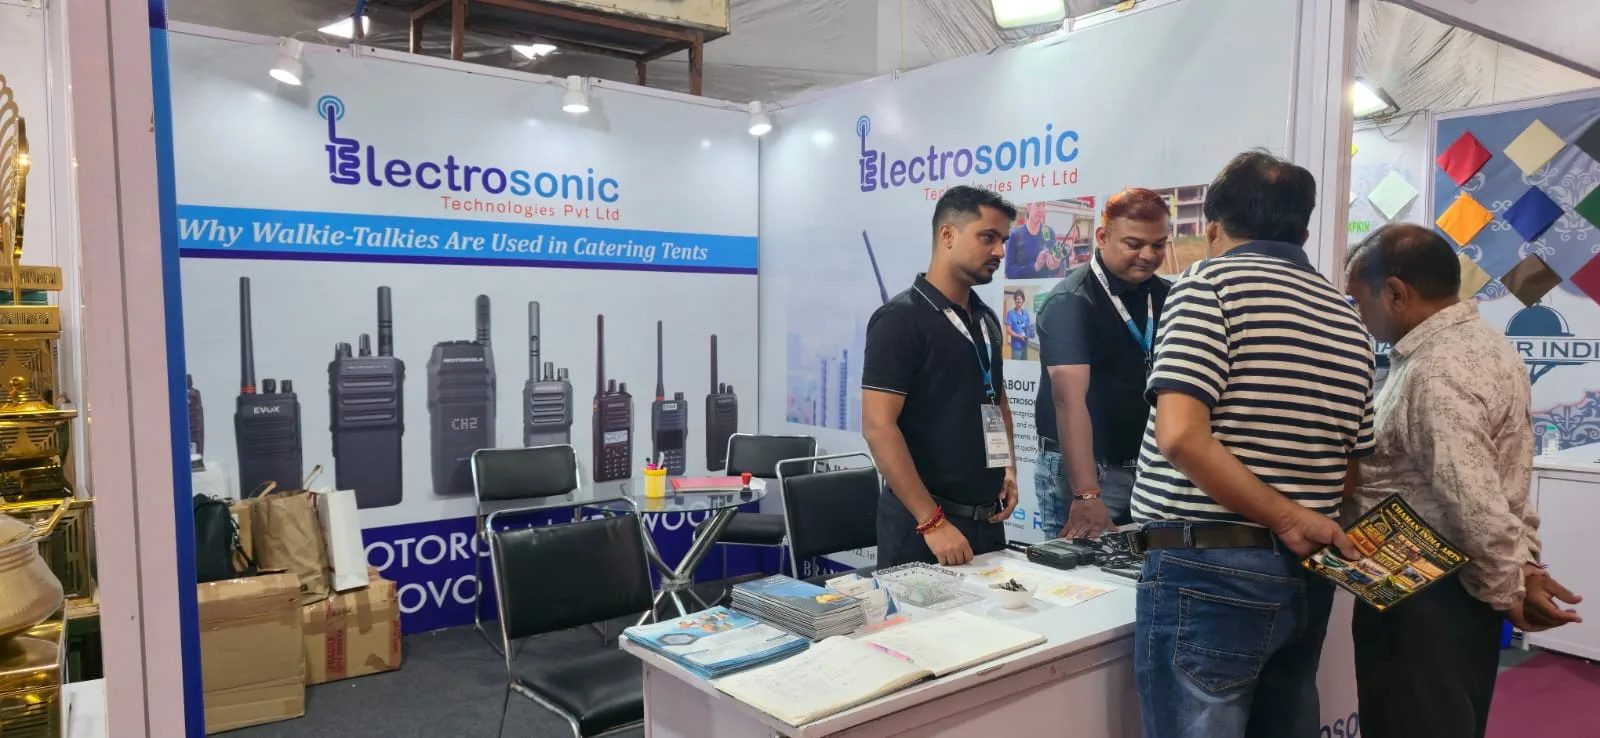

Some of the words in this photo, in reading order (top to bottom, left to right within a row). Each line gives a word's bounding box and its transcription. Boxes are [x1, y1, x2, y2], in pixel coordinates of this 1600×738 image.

[923, 179, 1013, 201] Tecogies
[1020, 172, 1046, 190] Pvt
[1052, 167, 1079, 186] Ltd
[440, 195, 556, 218] Technologies
[563, 204, 590, 219] Pvt
[596, 207, 621, 221] Ltd
[178, 217, 244, 248] Why
[252, 220, 440, 250] Walkie-Talkies
[444, 231, 486, 251] Are
[491, 232, 545, 254] Used
[548, 235, 568, 255] in
[573, 236, 657, 263] Catering
[661, 241, 709, 261] Tents
[1542, 341, 1600, 359] INDI
[1003, 379, 1036, 392] ABOUT
[451, 417, 478, 431] CH2
